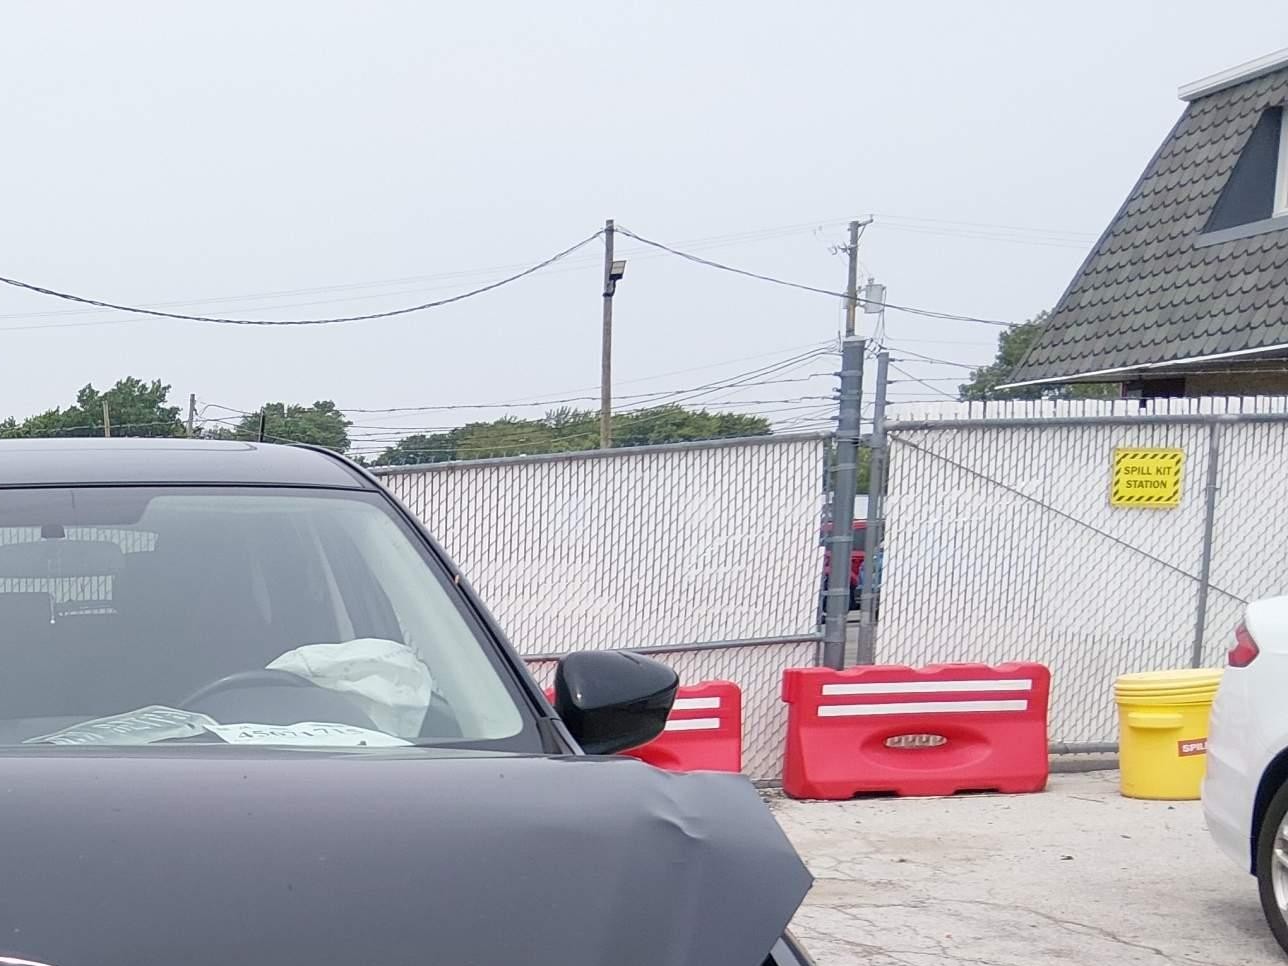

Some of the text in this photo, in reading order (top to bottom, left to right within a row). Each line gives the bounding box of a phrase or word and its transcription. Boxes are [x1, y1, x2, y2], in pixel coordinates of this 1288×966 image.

[1124, 466, 1172, 475] SPILL KIT
[1126, 480, 1167, 488] STATION
